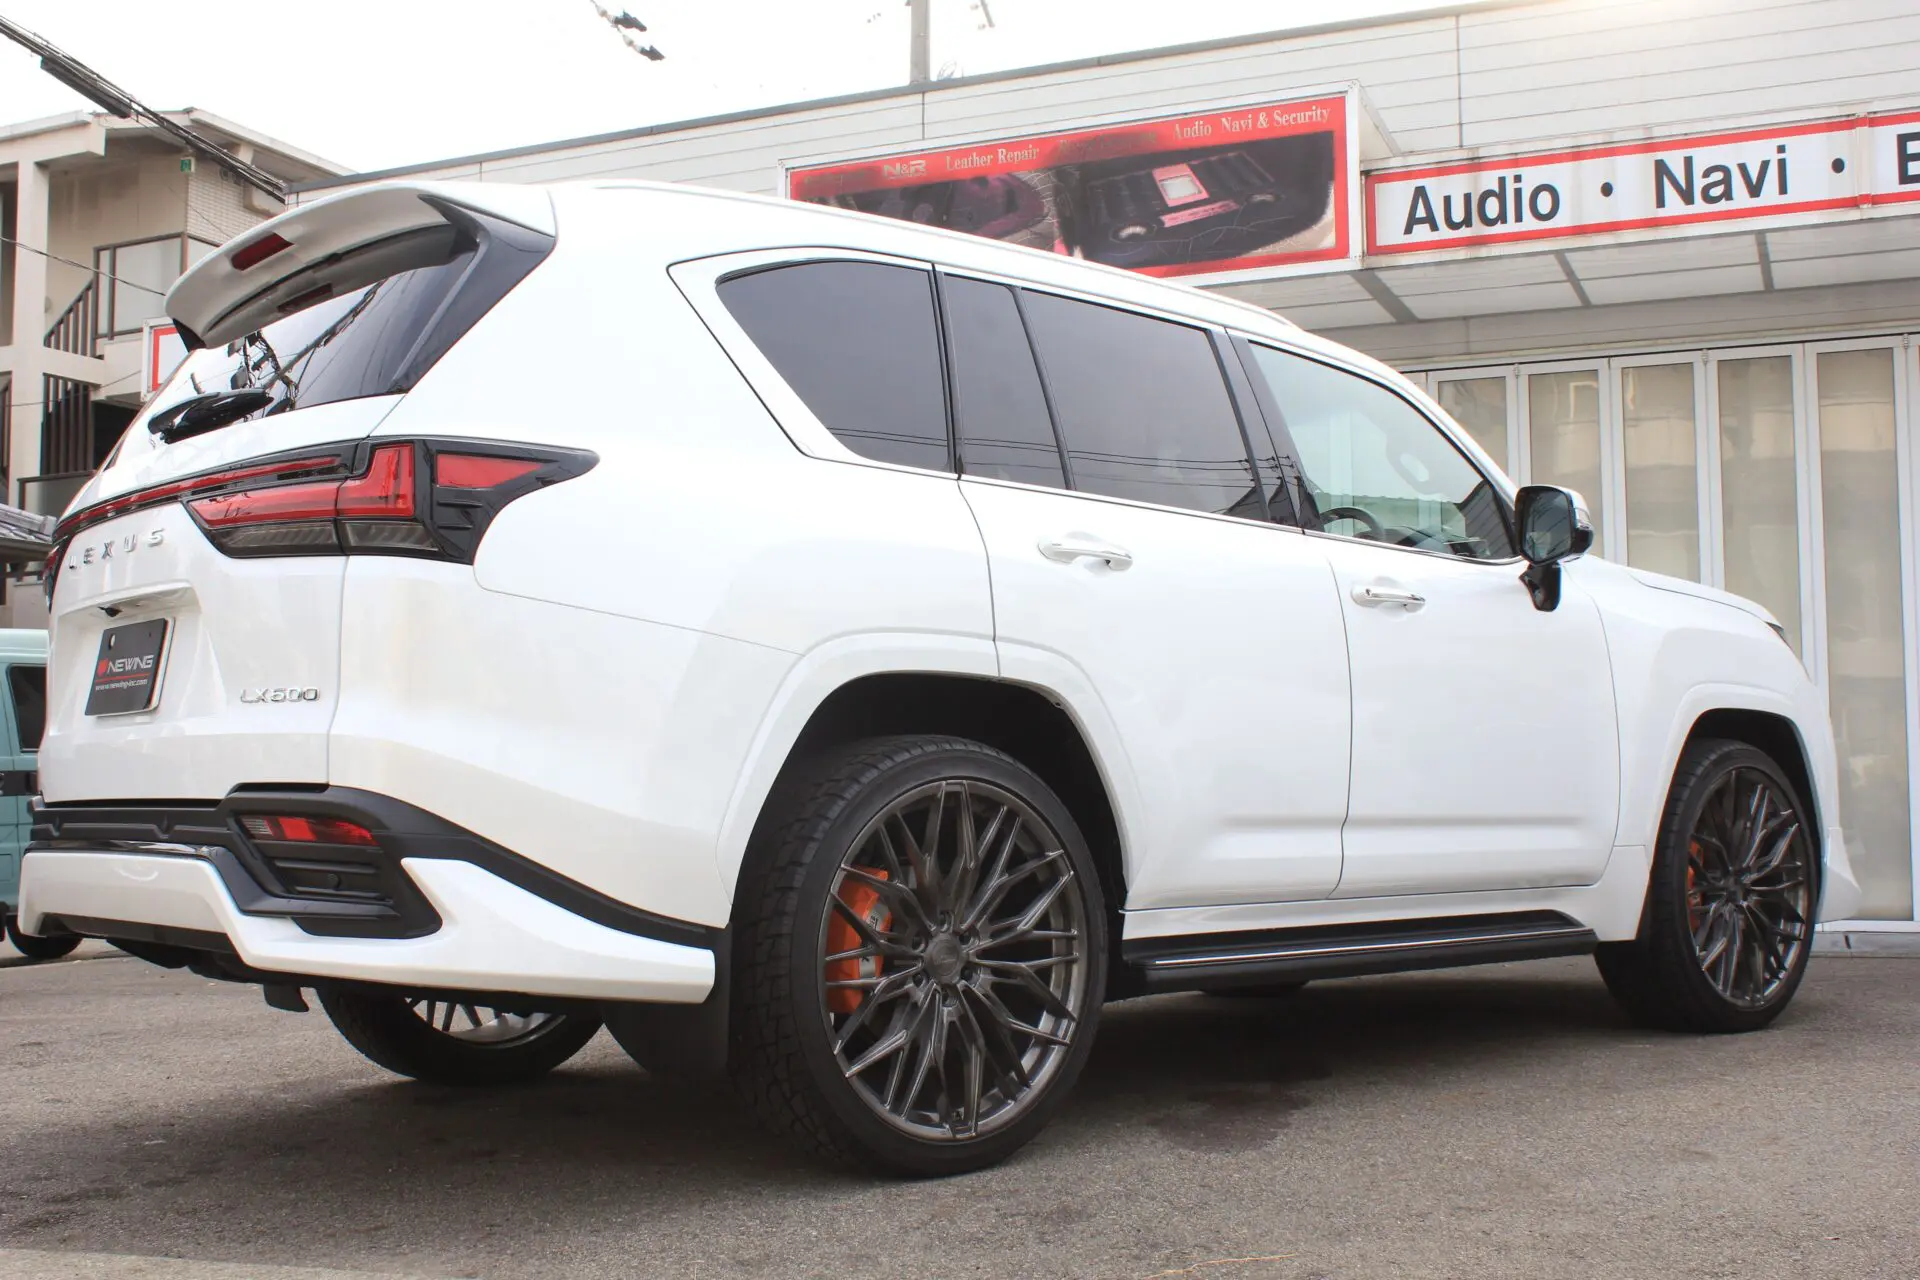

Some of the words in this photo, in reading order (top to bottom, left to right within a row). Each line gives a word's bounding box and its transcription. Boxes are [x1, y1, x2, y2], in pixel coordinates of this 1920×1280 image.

[1173, 120, 1212, 141] Audio
[1220, 114, 1252, 132] Navi
[1257, 112, 1270, 129] &
[1273, 105, 1331, 127] Security
[883, 159, 927, 177] N&R
[946, 152, 993, 171] Leather
[998, 145, 1040, 165] Repair
[1402, 173, 1561, 236] Audio
[1654, 144, 1789, 210] Navi
[69, 528, 165, 570] LEXUS
